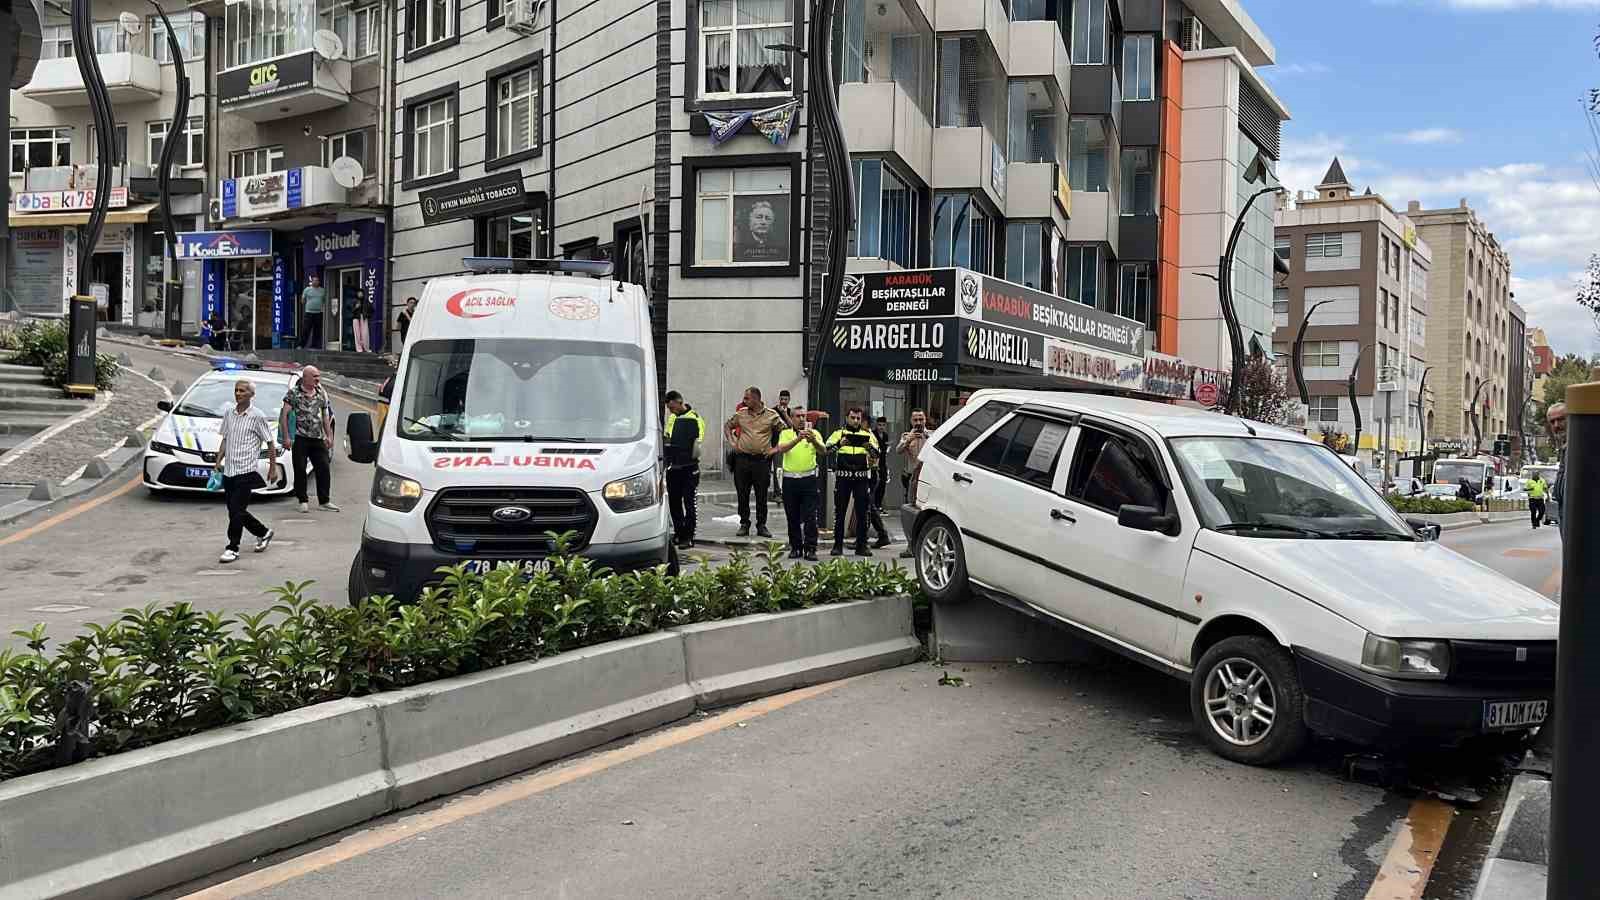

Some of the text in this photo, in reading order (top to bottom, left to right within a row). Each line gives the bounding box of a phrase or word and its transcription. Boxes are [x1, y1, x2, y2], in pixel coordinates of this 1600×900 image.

[251, 64, 277, 85] arc
[78, 191, 94, 207] 78
[486, 186, 517, 199] TOBACCO
[886, 274, 932, 285] KARABÜK
[872, 287, 946, 300] BEŞİKTAŞLILAR
[886, 299, 929, 311] DERNEĞİ
[982, 288, 1128, 345] KARABÜK BEŞİKTAŞLILAR DERNEĞİ
[850, 323, 944, 349] BARGELLO
[979, 328, 1029, 366] BARGELLO
[895, 369, 938, 381] BARGELLO
[474, 560, 491, 574] 78
[1490, 704, 1503, 725] 81
